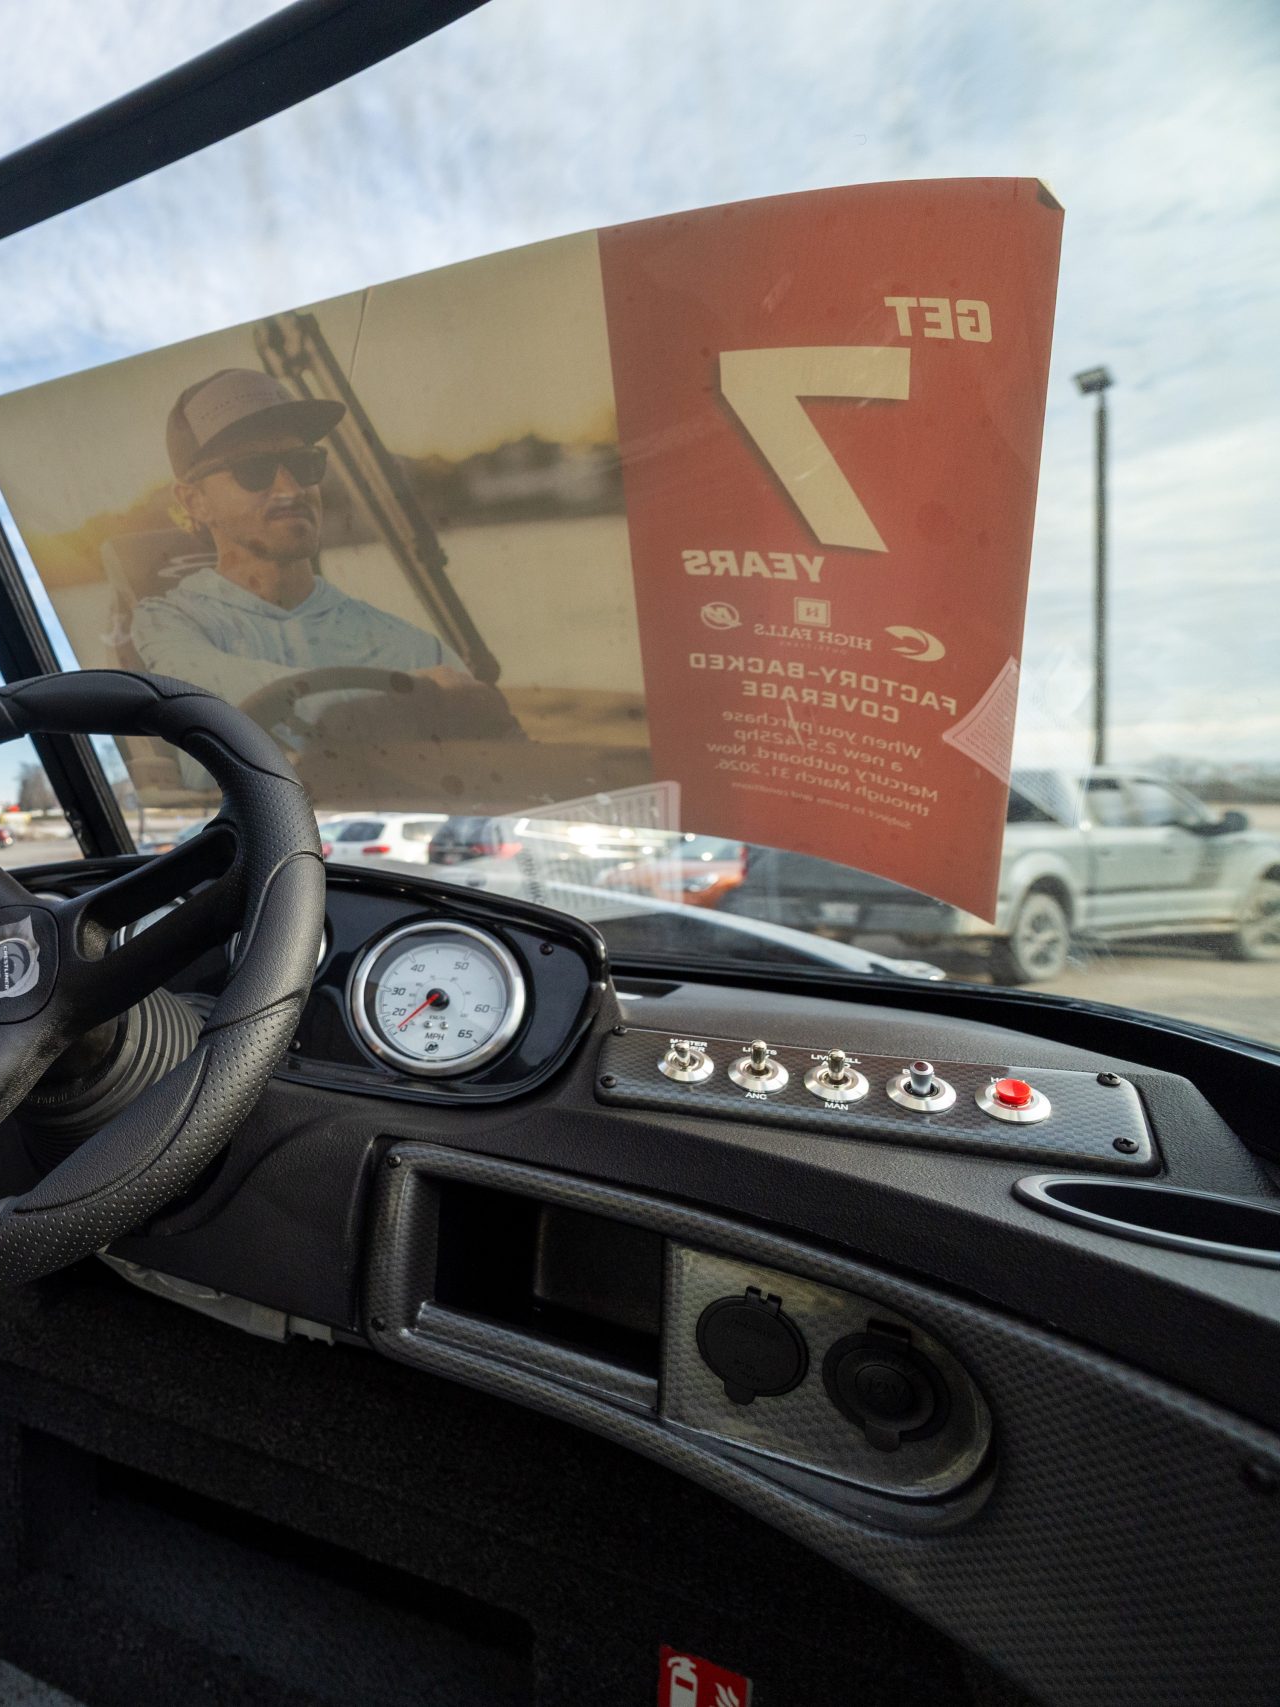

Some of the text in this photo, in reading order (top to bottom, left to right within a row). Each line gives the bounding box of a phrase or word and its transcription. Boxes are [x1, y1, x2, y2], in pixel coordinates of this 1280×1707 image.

[410, 964, 426, 973] 40
[453, 962, 469, 970] 50
[391, 988, 406, 996] 30
[392, 1008, 407, 1016] 20
[474, 1004, 490, 1013] 60
[425, 1032, 445, 1041] MPH
[457, 1029, 474, 1038] 65
[670, 1038, 708, 1047] MSTER
[742, 1047, 778, 1056] LITS
[745, 1092, 767, 1100] ANC
[824, 1101, 849, 1110] MAN
